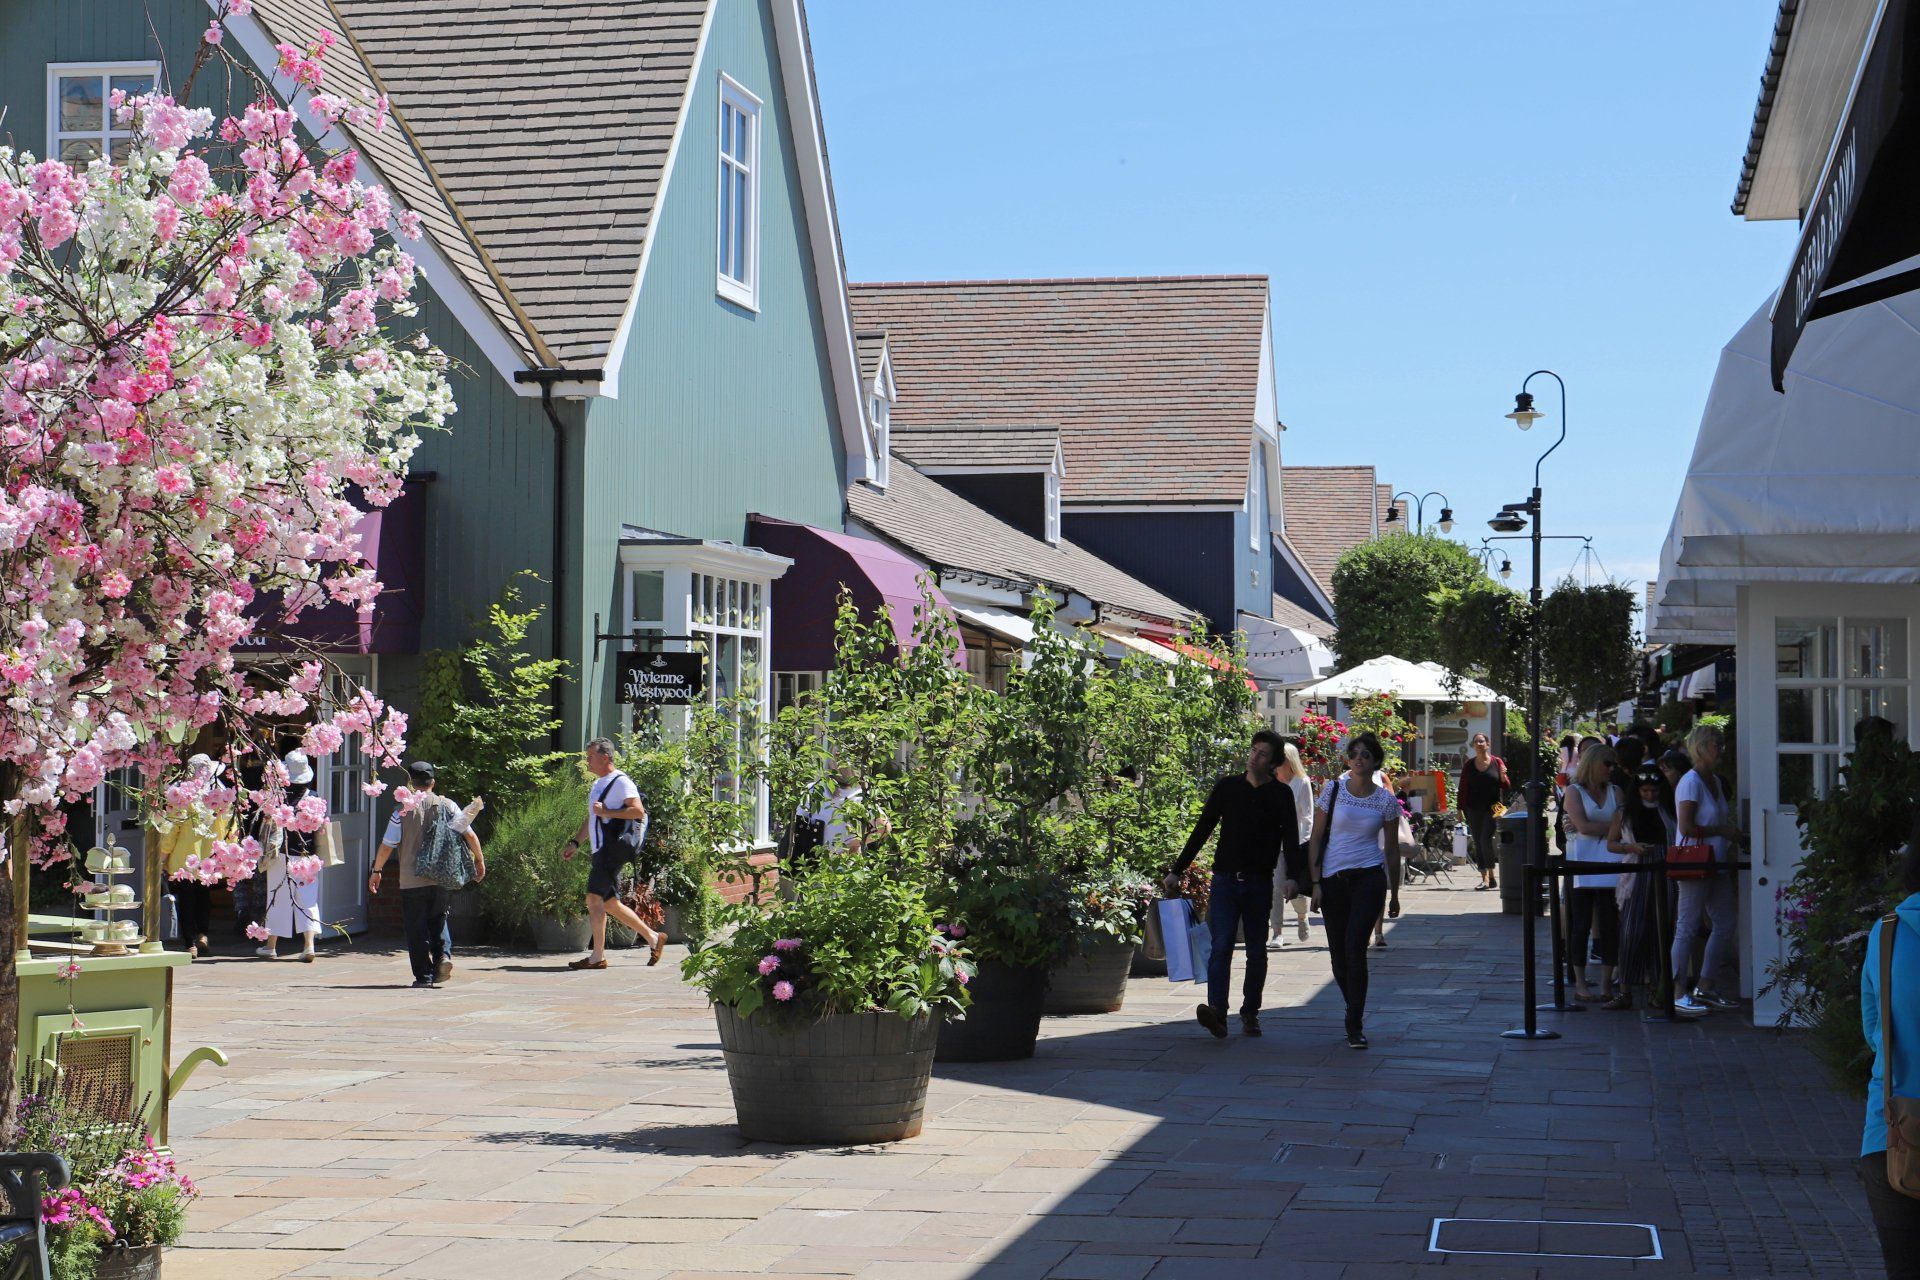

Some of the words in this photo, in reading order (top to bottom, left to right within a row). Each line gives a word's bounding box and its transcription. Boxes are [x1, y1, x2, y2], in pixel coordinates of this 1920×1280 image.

[1795, 213, 1826, 328] ORLEBAR
[1827, 126, 1856, 259] BROWN
[628, 668, 684, 684] Vivienne
[624, 682, 693, 698] Westwood
